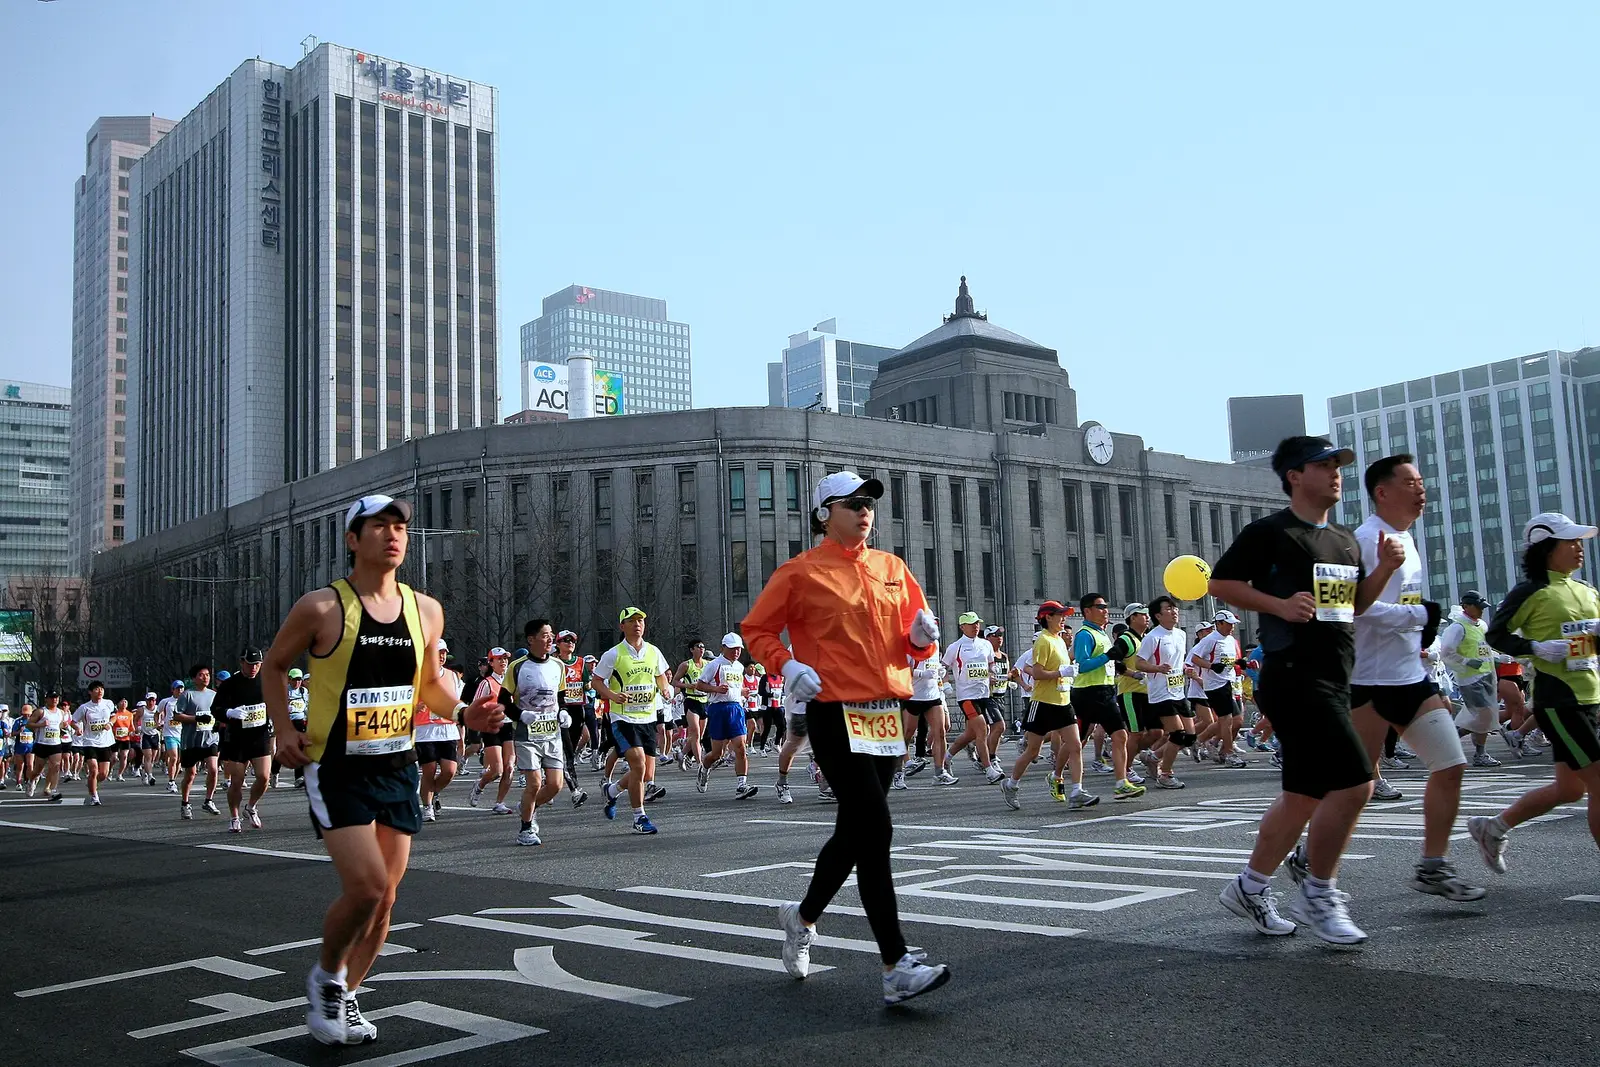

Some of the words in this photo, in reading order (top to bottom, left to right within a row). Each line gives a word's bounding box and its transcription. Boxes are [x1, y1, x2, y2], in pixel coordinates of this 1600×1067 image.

[364, 59, 469, 108] 서울신문
[380, 90, 449, 116] seoul.co.kr
[536, 369, 553, 379] ACE
[536, 388, 568, 410] AC
[349, 689, 412, 705] SAMSUNG
[355, 708, 408, 736] F4406
[531, 721, 556, 733] E2103
[848, 713, 898, 738] E7133
